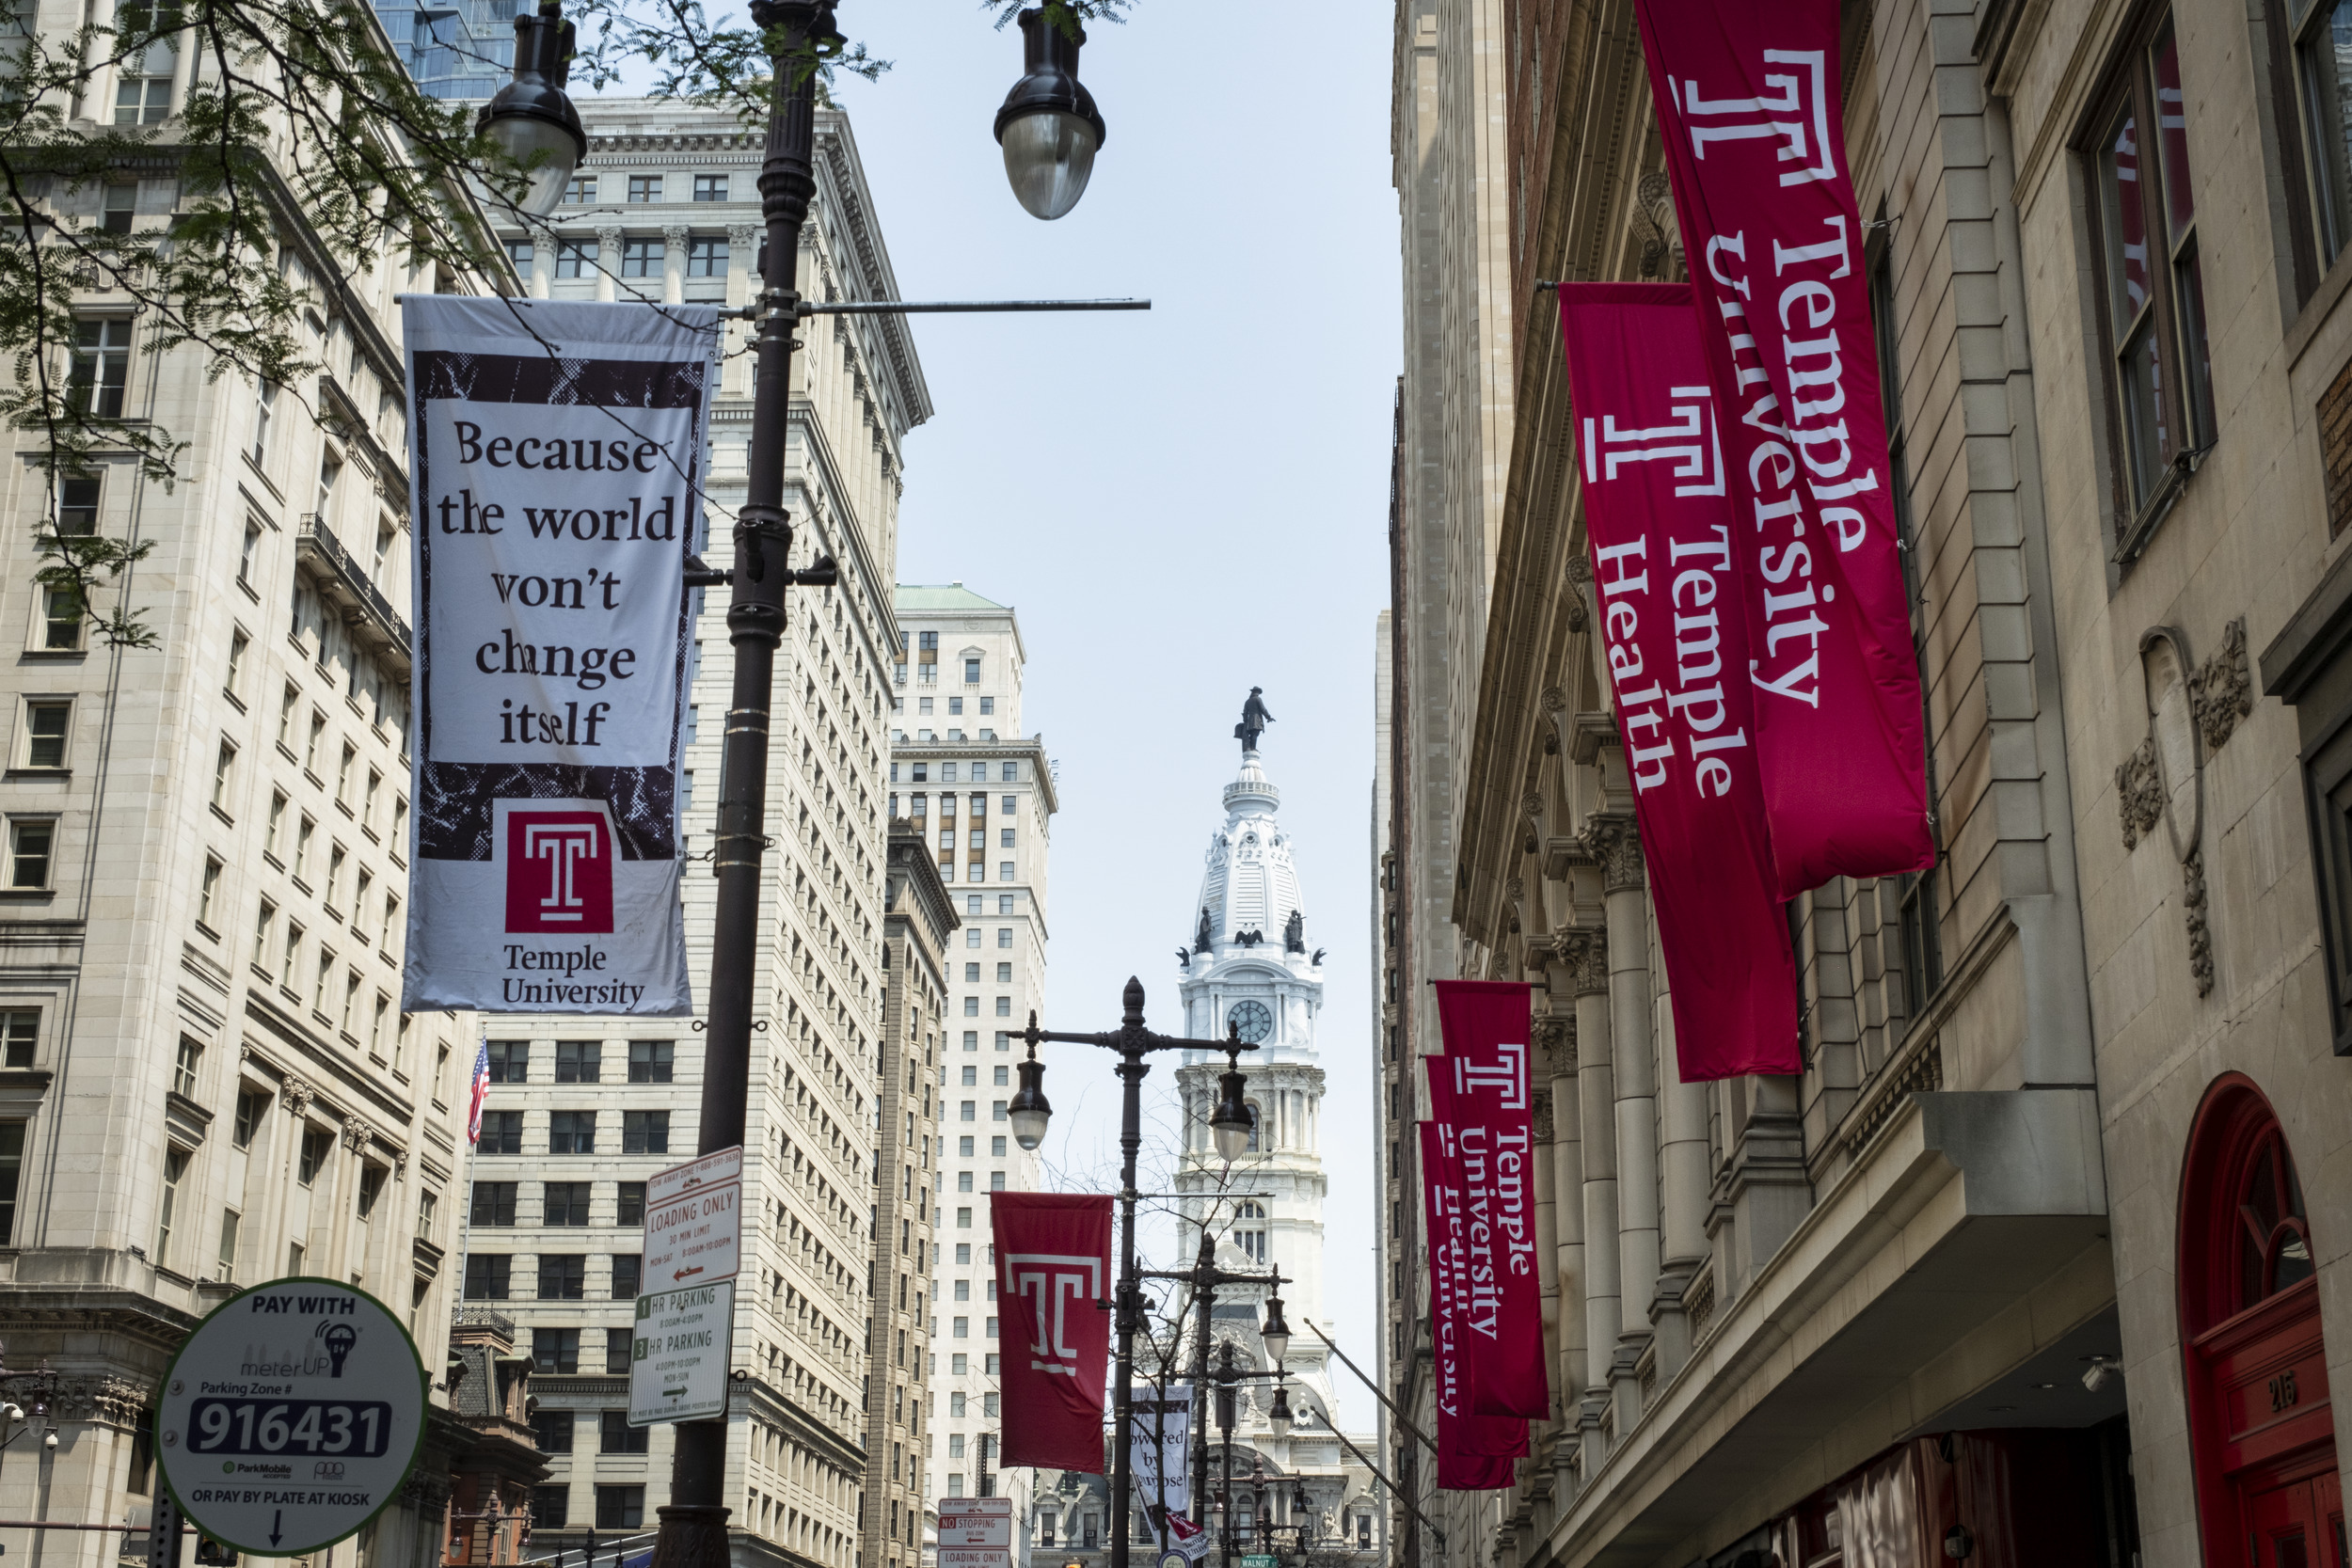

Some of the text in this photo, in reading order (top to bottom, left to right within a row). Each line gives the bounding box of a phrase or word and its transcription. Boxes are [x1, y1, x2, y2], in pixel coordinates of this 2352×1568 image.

[1773, 214, 1879, 552] Temple
[454, 421, 659, 472] Because
[1706, 230, 1835, 709] University
[437, 489, 676, 541] the world
[491, 568, 621, 610] won't
[476, 628, 636, 689] change
[1597, 534, 1675, 797] Health
[1665, 525, 1747, 800] Temple
[501, 699, 610, 746] itself
[504, 944, 607, 977] Temple
[502, 978, 644, 1010] University
[651, 1152, 739, 1188] TOW AWAY ZONE 1-888-591-3636
[651, 1192, 733, 1233] LOADING ONLY
[1496, 1125, 1534, 1276] Temple
[670, 1225, 710, 1245] 30 MIN LIMIT
[1460, 1125, 1503, 1340] University
[650, 1237, 731, 1267] MON-SAT 8:00AM-10:00PM
[252, 1296, 356, 1315] PAY WITH
[652, 1297, 664, 1313] HR
[671, 1288, 715, 1310] PARKING
[639, 1330, 711, 1357] 3 HR PARKING
[200, 1382, 292, 1396] Parking Zone #
[664, 1372, 689, 1383] MON-SUN
[199, 1403, 380, 1452] 916431
[237, 1464, 292, 1473] ParkMobile
[192, 1490, 369, 1505] OR PAY BY PLATE AT KIOSK
[942, 1519, 994, 1528] NO STOPPING
[946, 1553, 1002, 1561] LOADING ONLY
